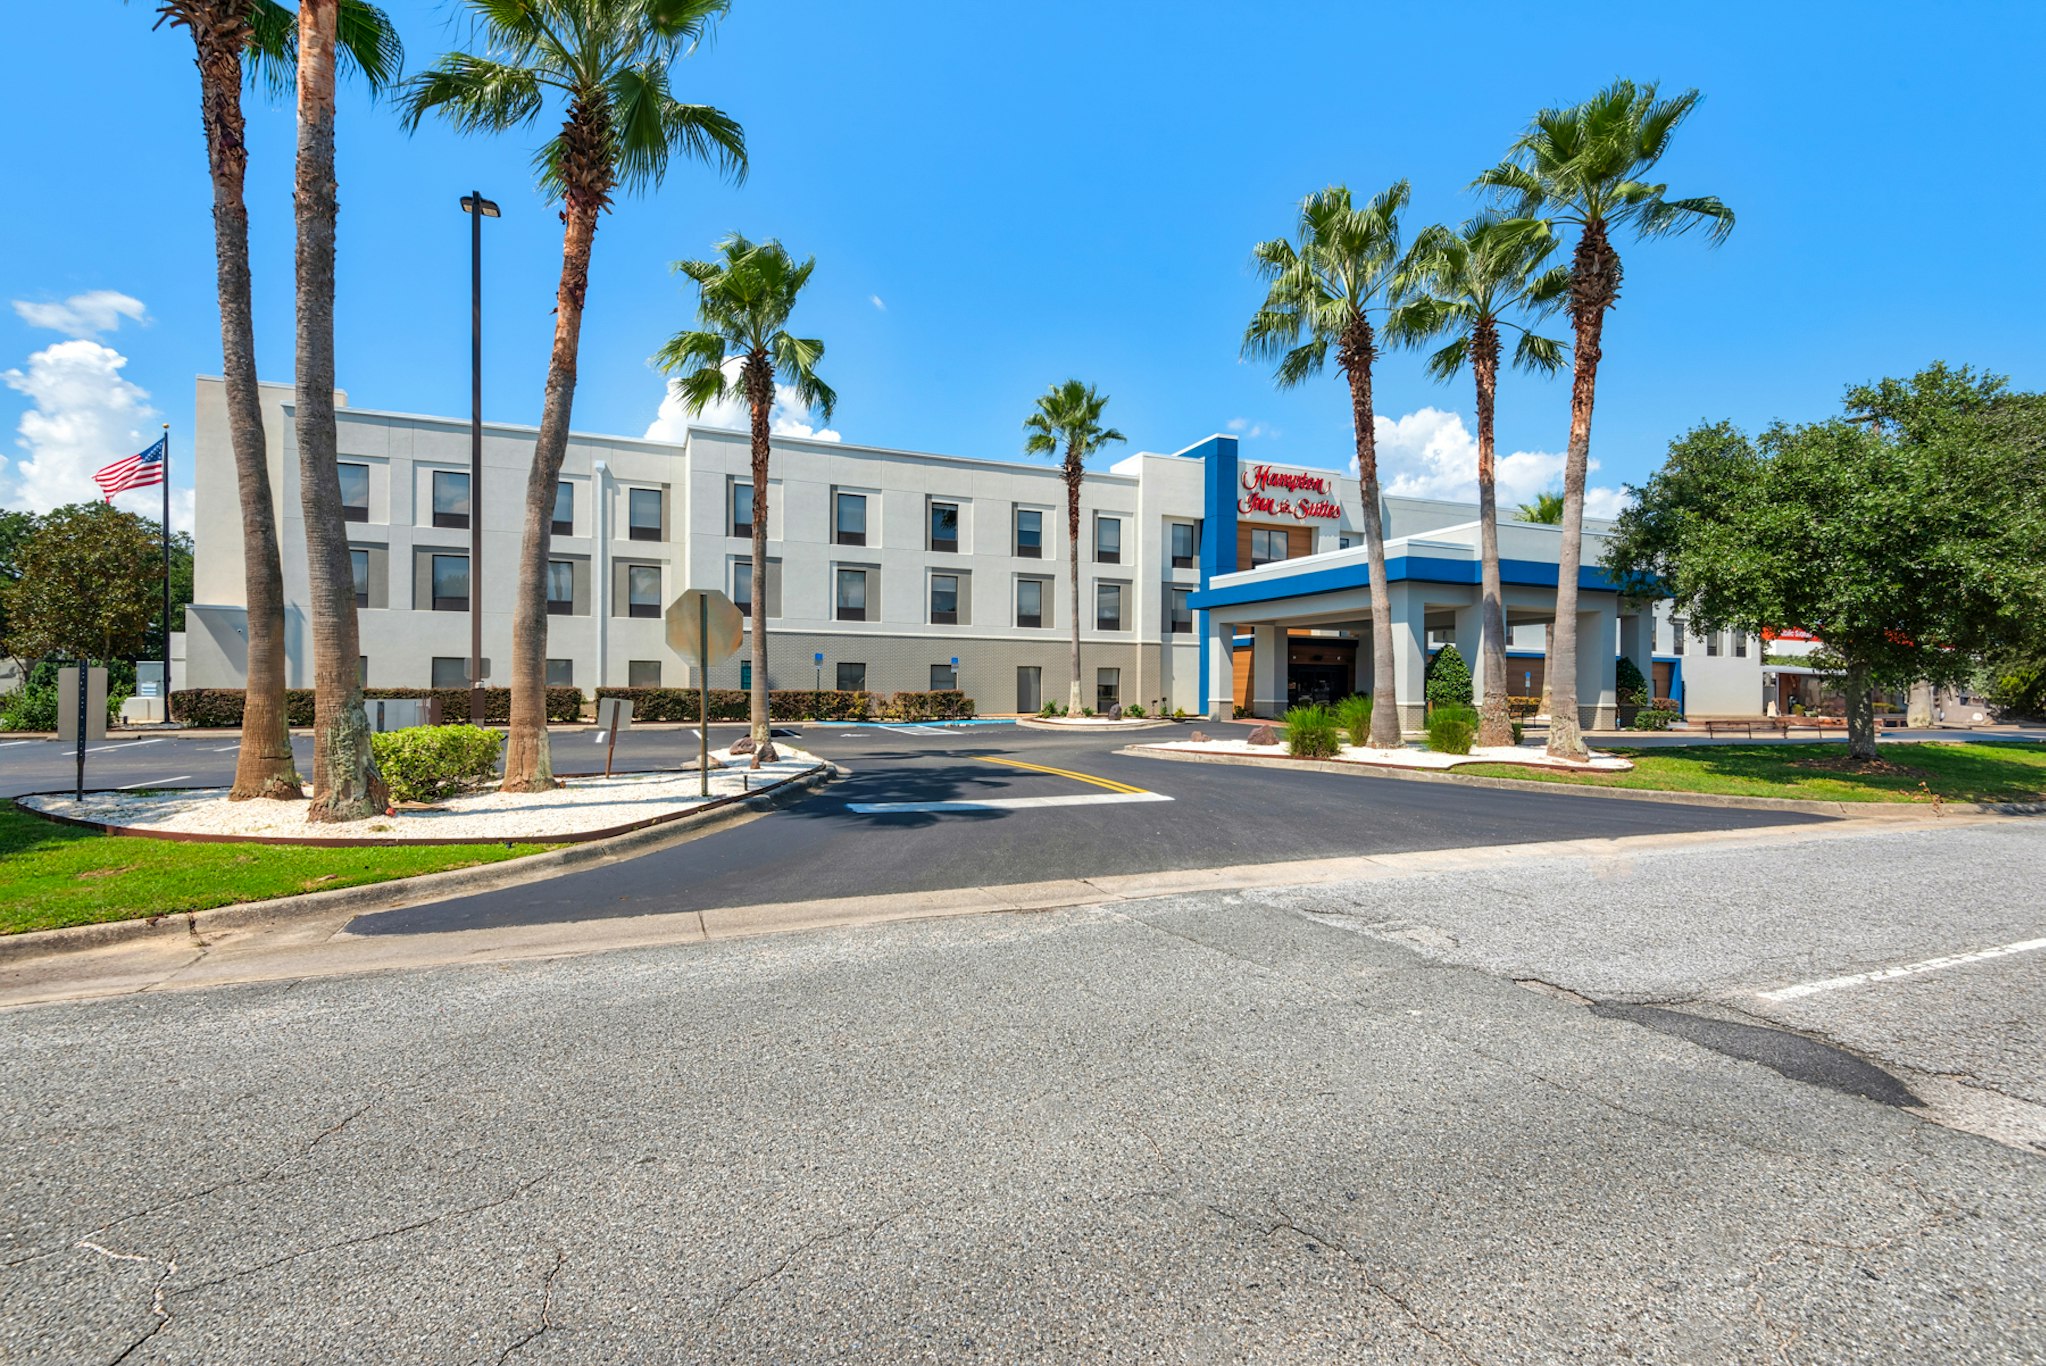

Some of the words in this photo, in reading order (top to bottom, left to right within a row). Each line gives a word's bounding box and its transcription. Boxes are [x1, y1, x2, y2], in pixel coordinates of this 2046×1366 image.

[1242, 465, 1331, 495] Hampton
[1238, 492, 1281, 516] Inn
[1279, 499, 1293, 514] &
[1293, 498, 1341, 520] Suites
